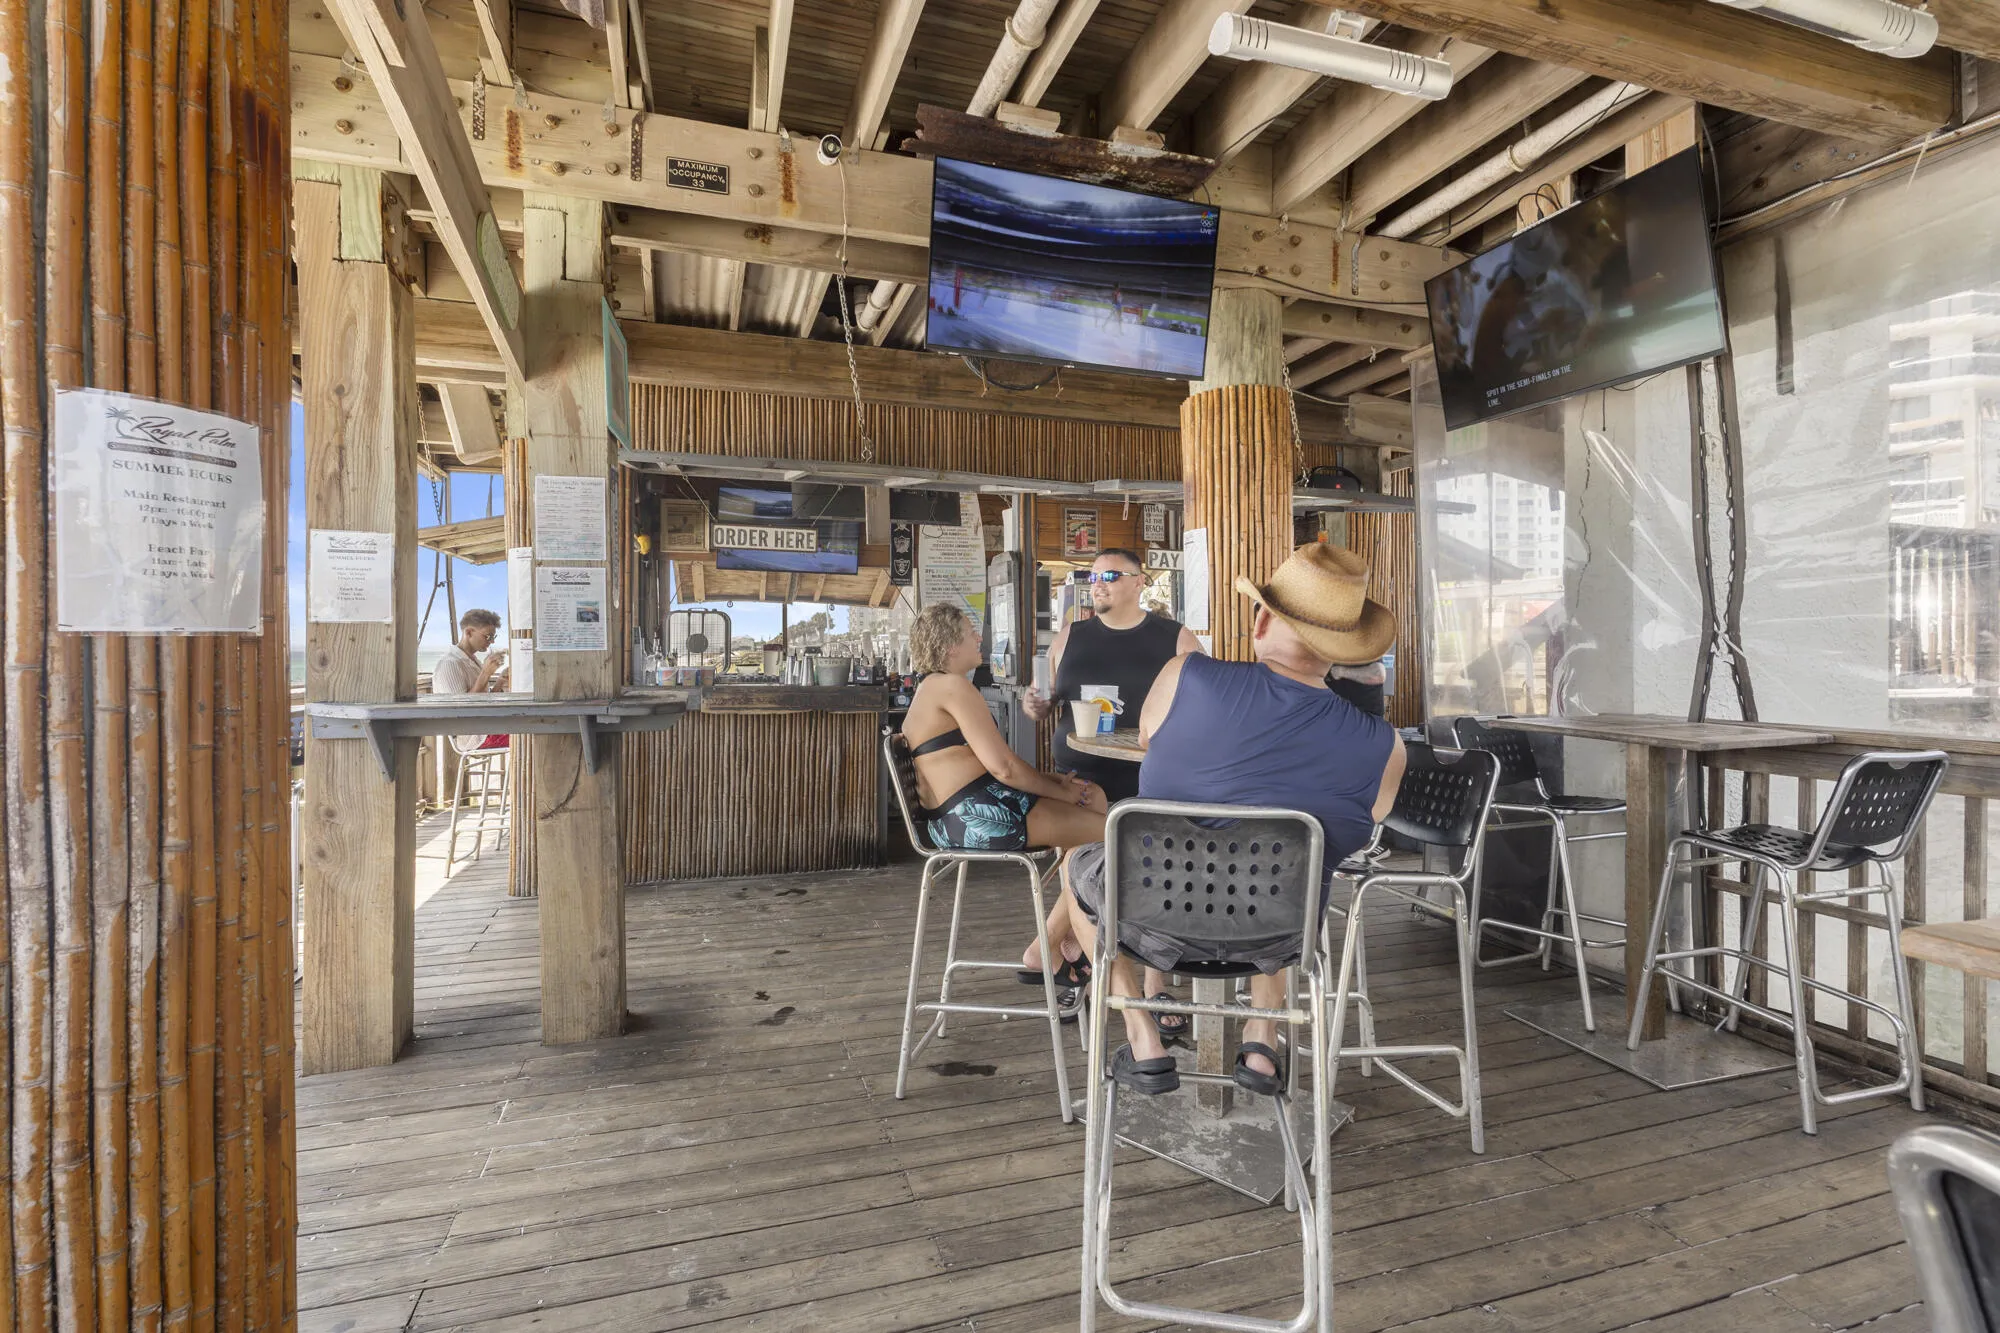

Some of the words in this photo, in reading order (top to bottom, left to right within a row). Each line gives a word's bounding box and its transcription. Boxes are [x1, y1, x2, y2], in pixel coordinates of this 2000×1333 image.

[672, 168, 723, 182] OCCUPANCY
[677, 161, 718, 173] MAXIMUM
[692, 179, 705, 188] 33
[1486, 387, 1499, 397] SPOT
[1500, 386, 1506, 394] IN
[1506, 382, 1516, 391] THE
[1517, 371, 1552, 388] SEMI-FINALS
[1552, 369, 1560, 377] ON
[1561, 364, 1572, 374] THE
[130, 416, 198, 445] Royal
[199, 428, 237, 449] Palm
[112, 459, 185, 476] SUMMER
[189, 469, 233, 484] HOURS
[124, 489, 159, 501] Main
[163, 493, 226, 509] Restaurant
[152, 516, 178, 527] Days
[714, 527, 768, 547] ORDER
[774, 530, 815, 549] HERE
[1148, 552, 1181, 568] PAY
